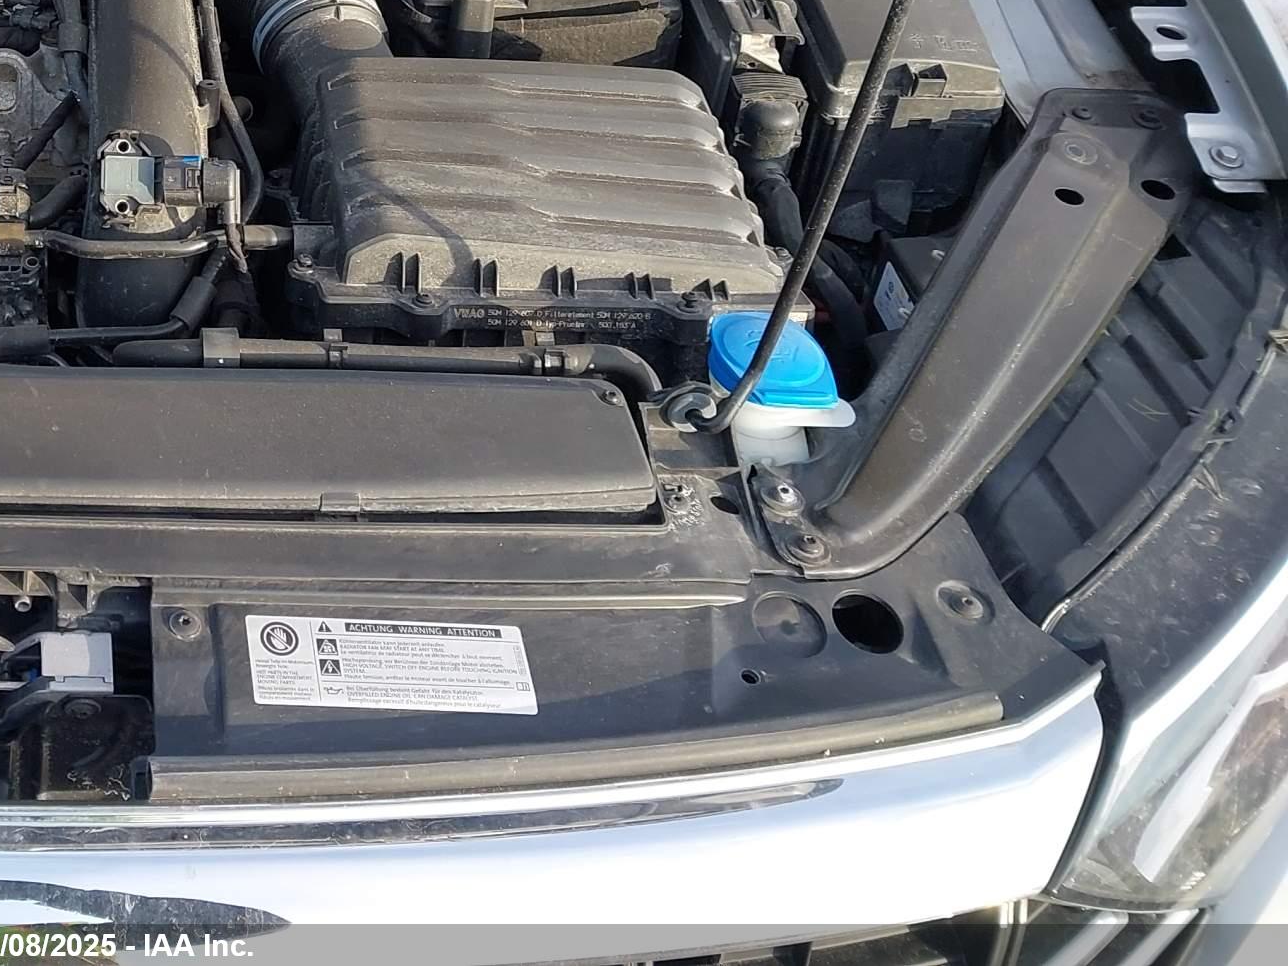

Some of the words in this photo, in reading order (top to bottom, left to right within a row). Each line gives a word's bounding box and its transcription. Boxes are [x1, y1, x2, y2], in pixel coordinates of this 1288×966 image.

[349, 624, 393, 632] ACHTUNG
[398, 626, 442, 634] WARNING
[447, 628, 495, 637] ATTENTION
